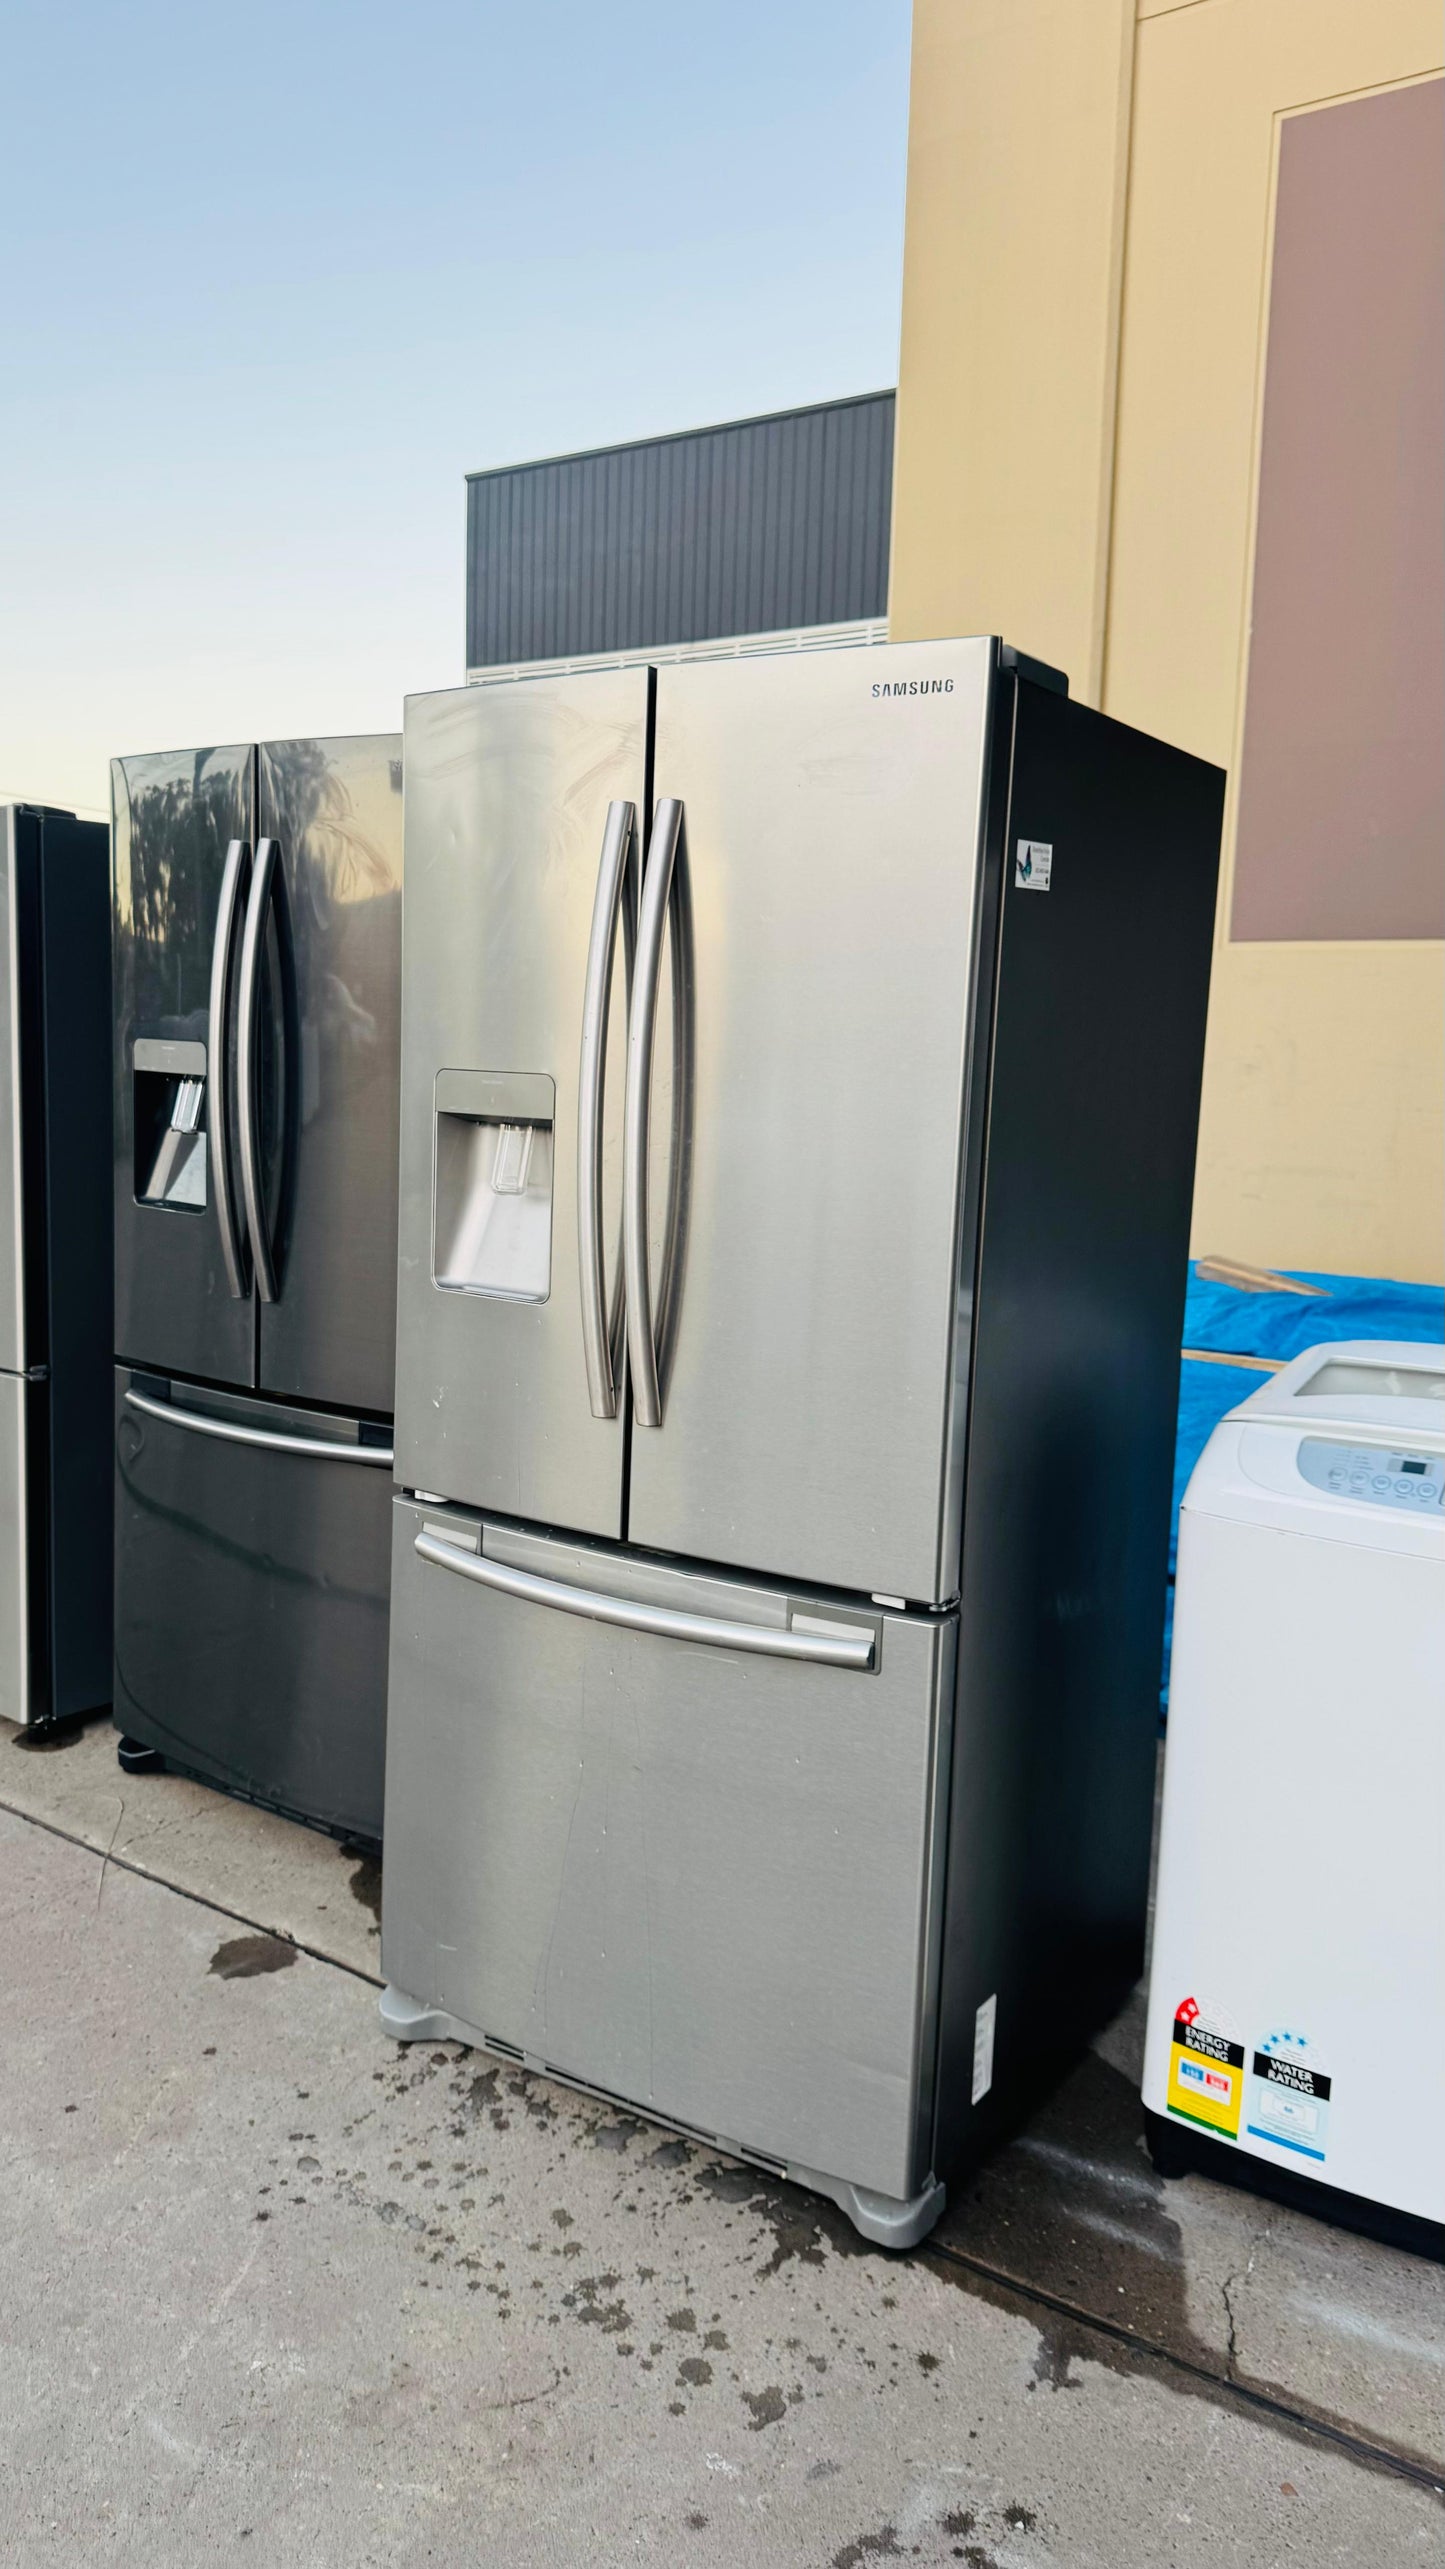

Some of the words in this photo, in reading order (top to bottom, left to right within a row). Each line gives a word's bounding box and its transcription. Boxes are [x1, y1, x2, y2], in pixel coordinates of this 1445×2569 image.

[872, 679, 954, 697] SAMSUNG
[1185, 2025, 1230, 2051] ENERGY
[1185, 2037, 1229, 2062] RATING
[1267, 2069, 1315, 2094] RATING
[1270, 2059, 1314, 2083] WATER
